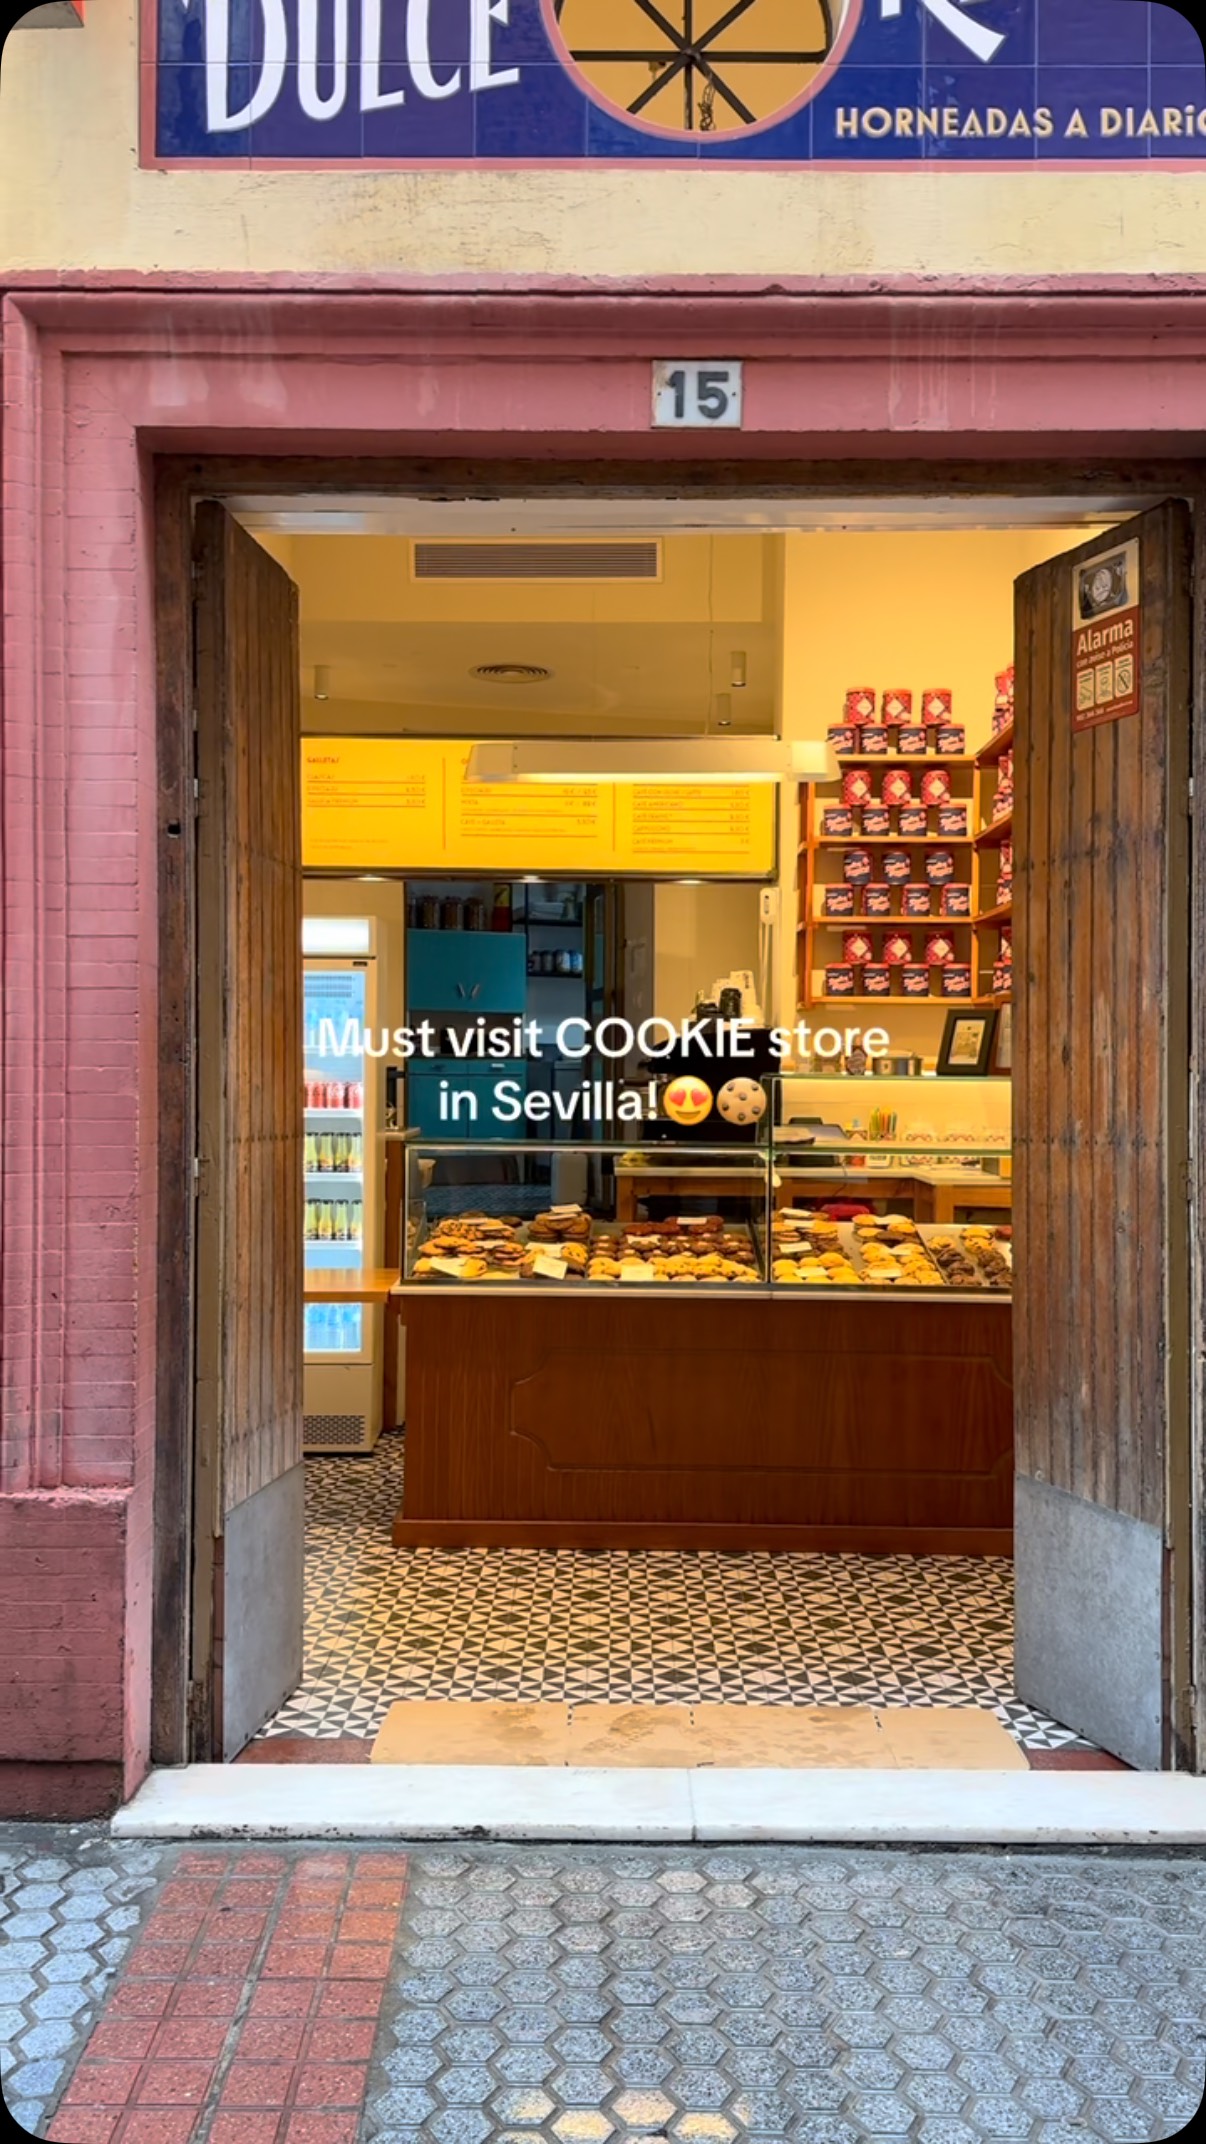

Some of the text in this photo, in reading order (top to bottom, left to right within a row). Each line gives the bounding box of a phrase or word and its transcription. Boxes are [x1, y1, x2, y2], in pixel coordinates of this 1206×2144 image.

[835, 106, 1053, 138] HORNEADAS
[1064, 106, 1088, 138] A
[667, 370, 729, 420] 15
[1077, 618, 1134, 656] Alarma
